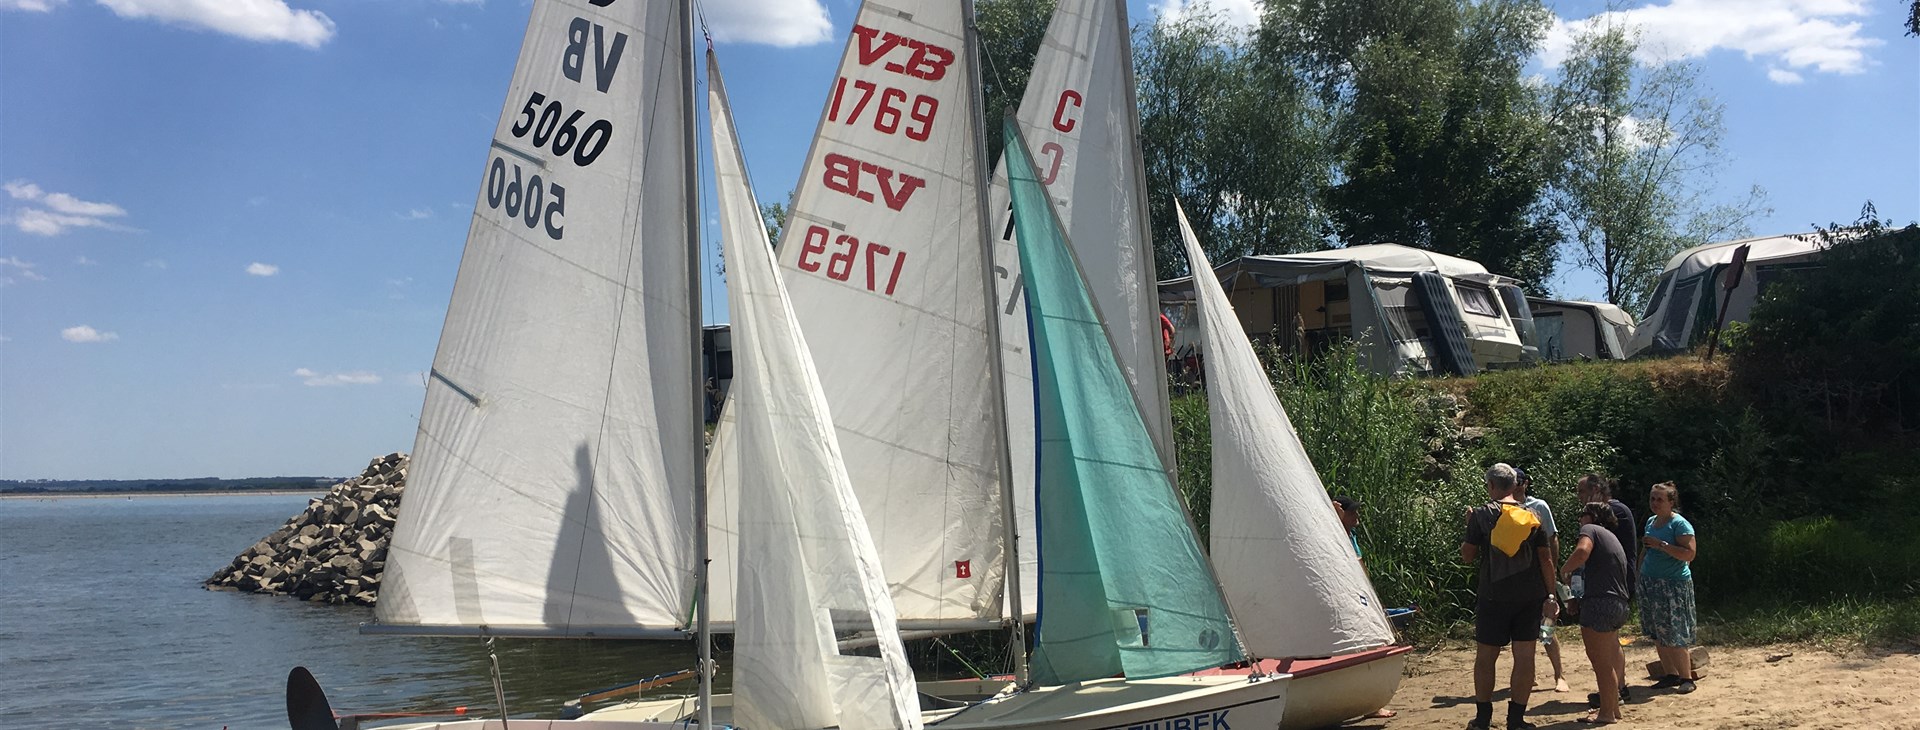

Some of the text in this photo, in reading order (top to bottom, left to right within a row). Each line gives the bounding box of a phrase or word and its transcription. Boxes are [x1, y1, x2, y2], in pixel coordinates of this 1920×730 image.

[851, 24, 956, 82] VB
[511, 91, 613, 167] 5060
[828, 76, 940, 143] 1769
[1052, 89, 1083, 133] C
